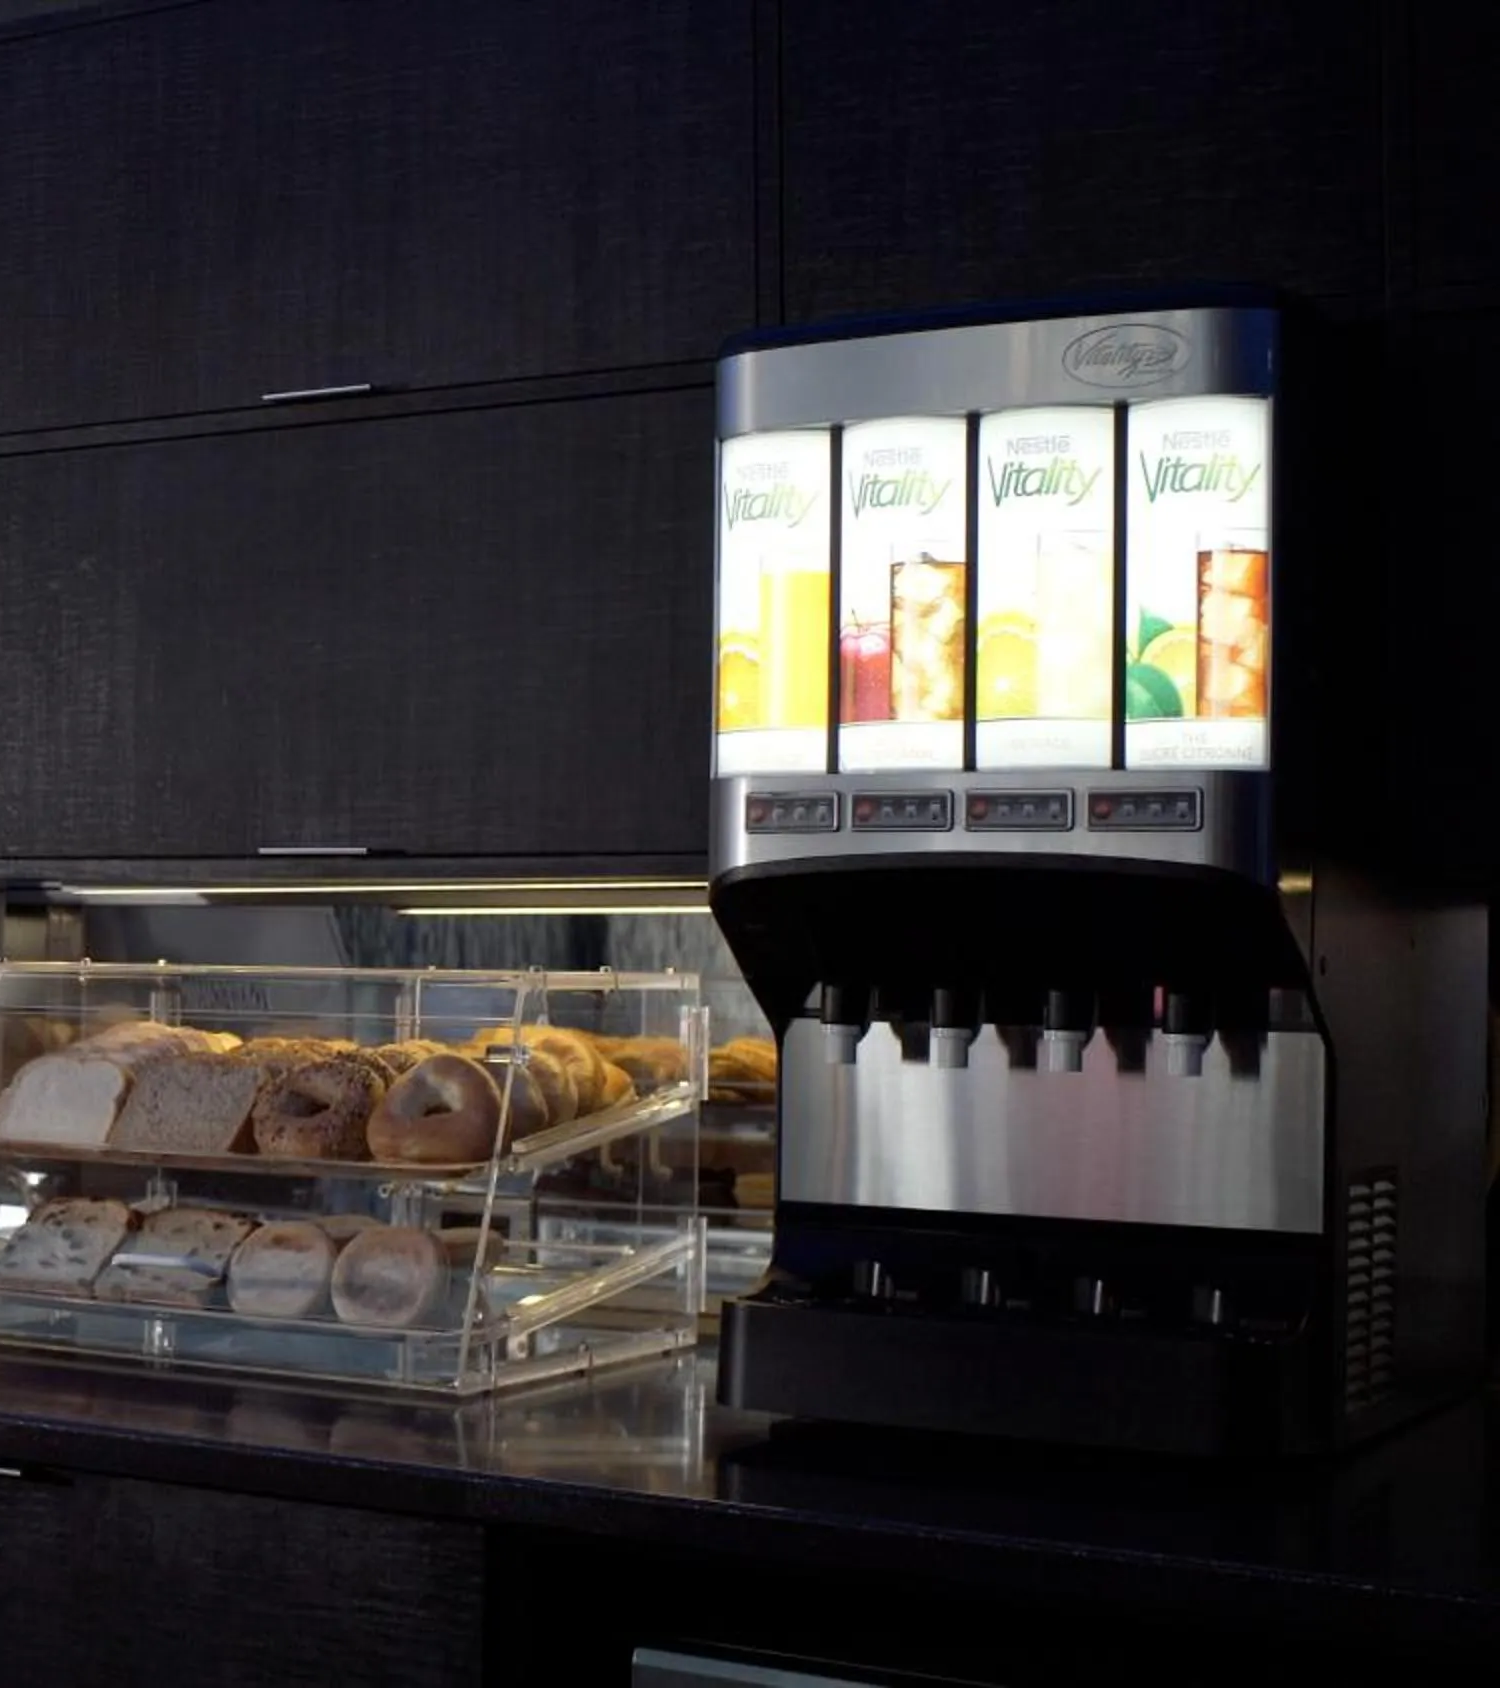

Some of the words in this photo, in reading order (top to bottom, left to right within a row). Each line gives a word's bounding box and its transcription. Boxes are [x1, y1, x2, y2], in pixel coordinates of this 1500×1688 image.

[848, 467, 952, 519] Vitality
[987, 455, 1103, 507] Vitality
[1139, 449, 1261, 503] Vitality
[723, 481, 821, 531] Vitality
